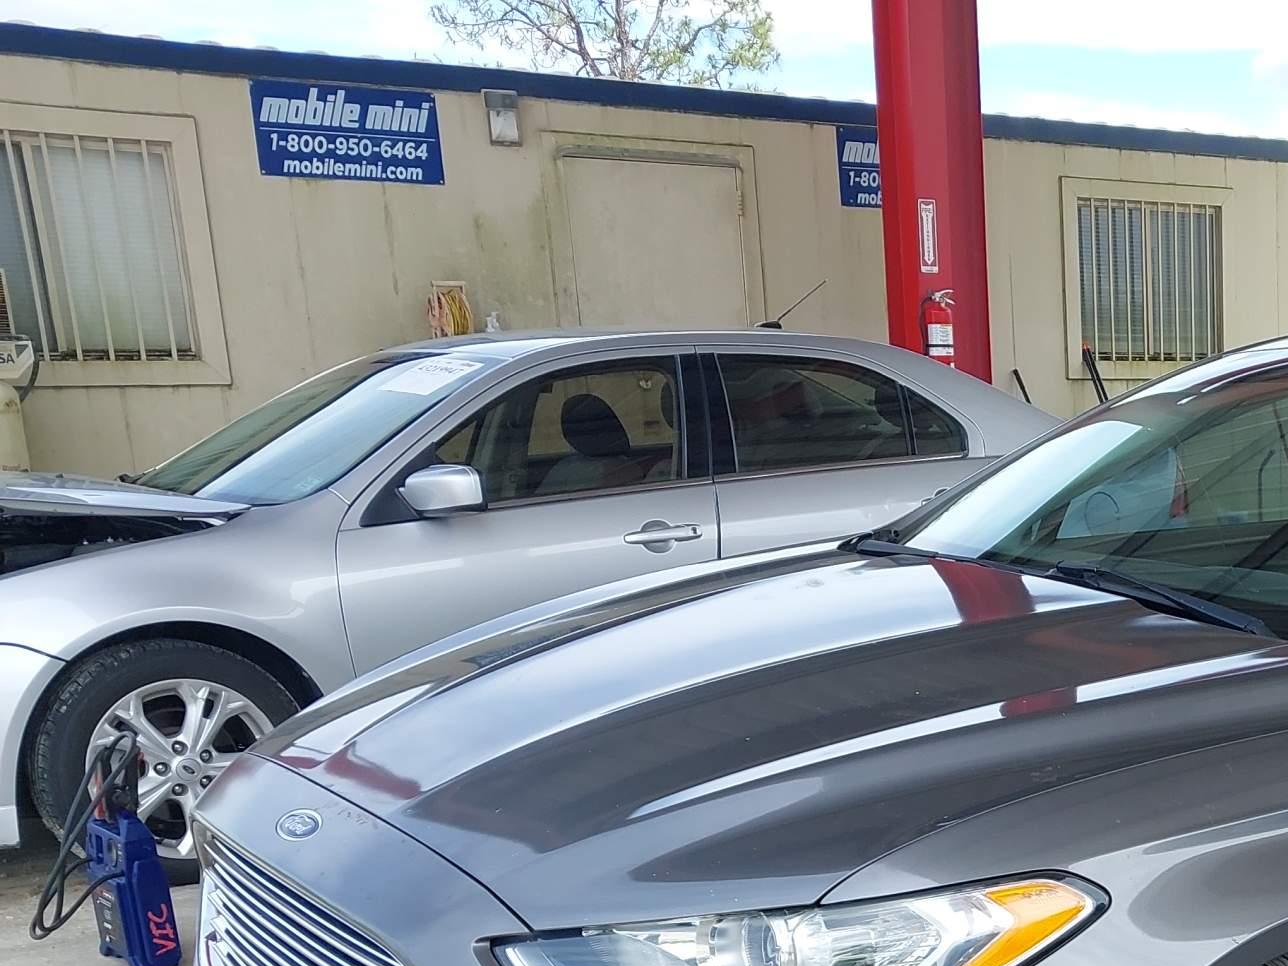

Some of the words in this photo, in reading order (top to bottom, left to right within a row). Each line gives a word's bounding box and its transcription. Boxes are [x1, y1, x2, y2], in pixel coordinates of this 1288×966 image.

[259, 87, 361, 128] mobile
[365, 100, 430, 133] mini
[270, 132, 428, 160] 1-800-950-6464
[283, 157, 423, 181] mobilemini.com
[147, 903, 177, 956] VIC
